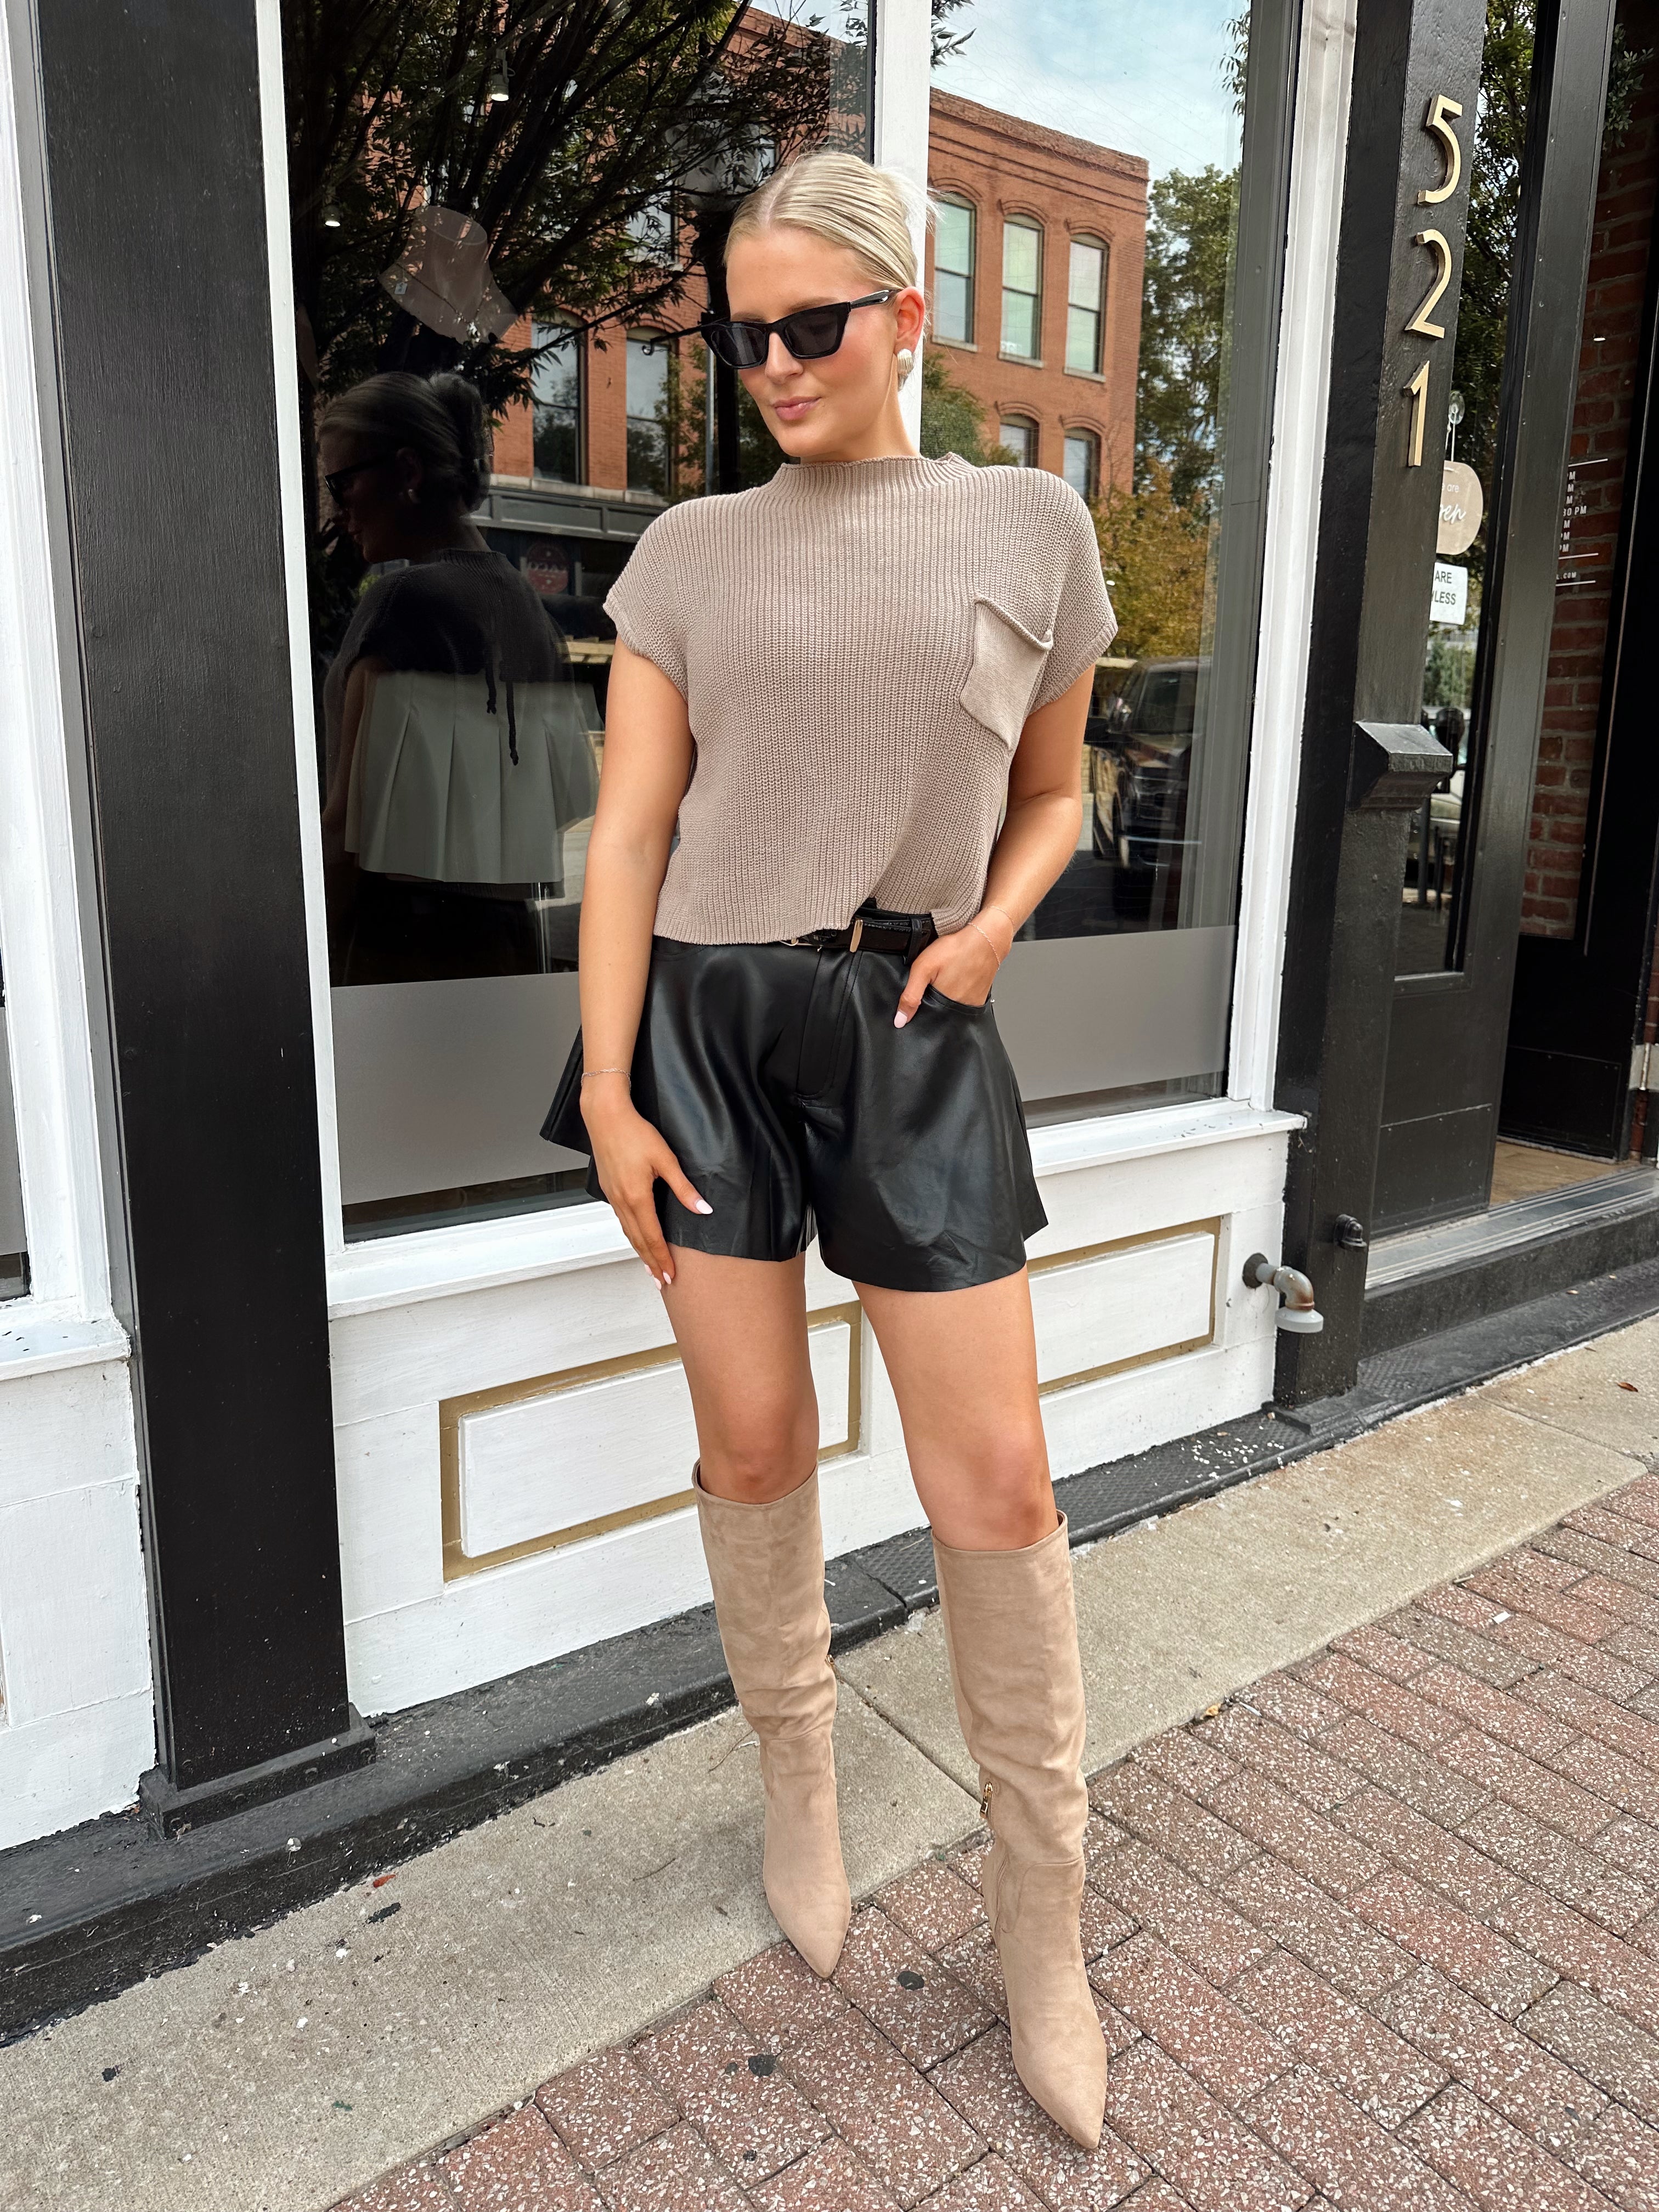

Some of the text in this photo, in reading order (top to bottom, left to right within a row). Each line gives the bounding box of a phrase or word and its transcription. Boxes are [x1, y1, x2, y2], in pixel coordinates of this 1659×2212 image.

[1403, 94, 1463, 466] 521
[1447, 484, 1459, 493] are
[1562, 505, 1587, 517] 30 PM
[1434, 570, 1452, 584] ARE
[1556, 571, 1577, 580] L.COM
[1431, 590, 1457, 606] LESS
